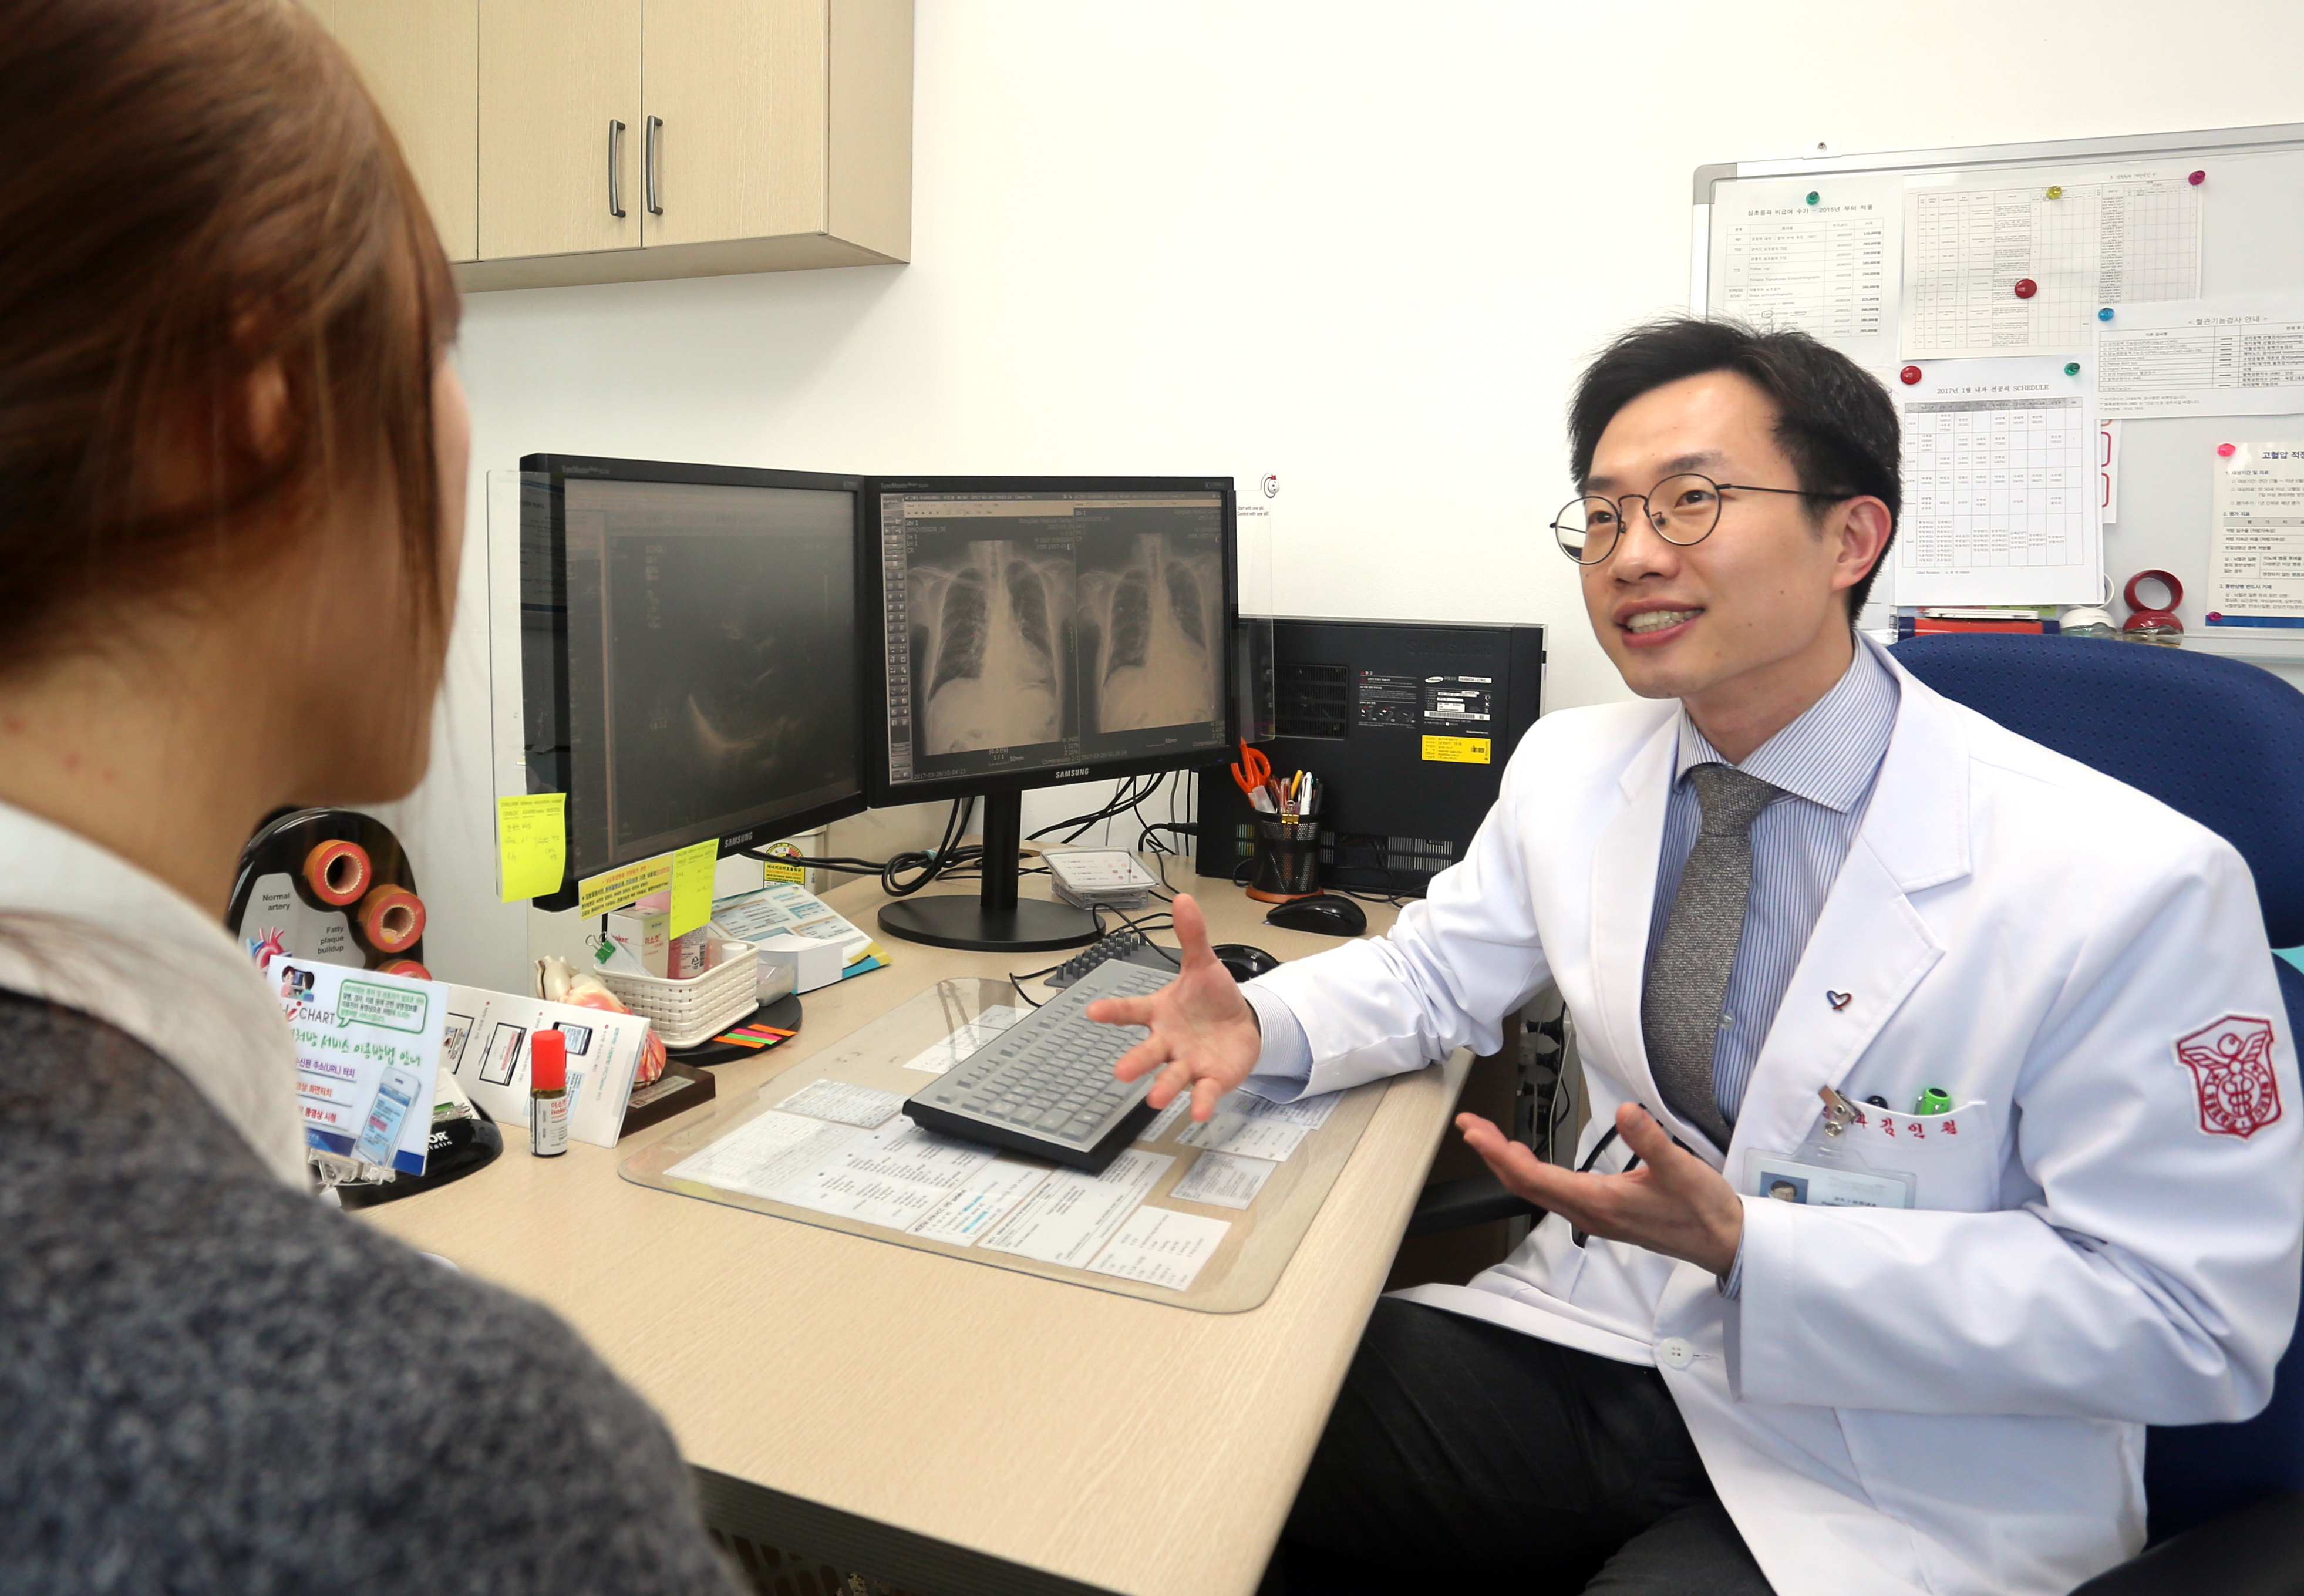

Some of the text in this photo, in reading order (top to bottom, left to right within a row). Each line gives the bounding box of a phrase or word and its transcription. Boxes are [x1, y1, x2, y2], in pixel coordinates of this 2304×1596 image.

[2195, 317, 2242, 325] 혈관기능검사
[2262, 451, 2289, 459] 고혈압
[1055, 767, 1090, 779] SAMSUNG
[724, 831, 753, 848] SAMSUNG
[262, 893, 291, 902] Normal
[268, 903, 291, 911] artery
[320, 935, 344, 946] plaque
[318, 945, 344, 955] buildup
[360, 1004, 382, 1014] 동영상으로
[291, 1028, 421, 1067] 처방 서비스 이용방법 안내
[313, 1061, 341, 1075] 주소(URL)
[343, 1068, 355, 1078] 터치
[295, 1081, 332, 1098] 영상 화면터치
[305, 1107, 323, 1120] 동영상
